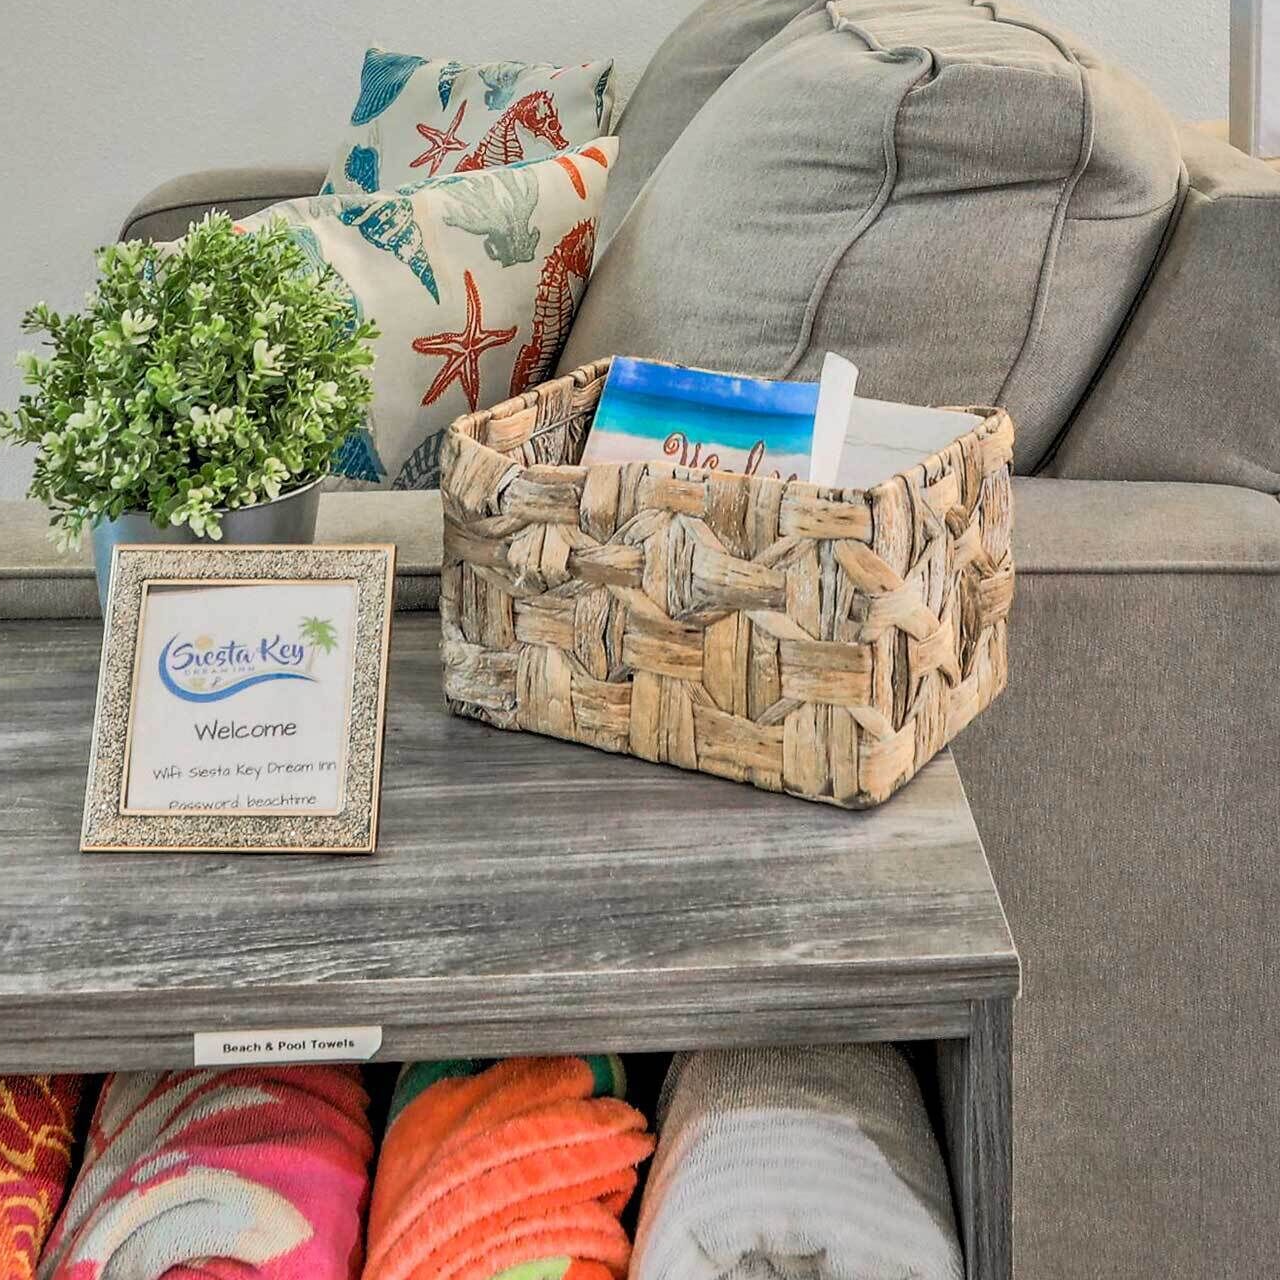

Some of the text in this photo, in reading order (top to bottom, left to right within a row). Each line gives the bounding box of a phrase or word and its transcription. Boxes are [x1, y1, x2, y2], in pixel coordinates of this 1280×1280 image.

[171, 634, 305, 671] Siesta Key
[194, 720, 298, 741] Welcome
[187, 765, 231, 779] Siesta
[235, 763, 261, 784] Key
[267, 760, 314, 775] Dream
[318, 759, 337, 772] Inn
[222, 1038, 355, 1054] Beach & Pool Towels
